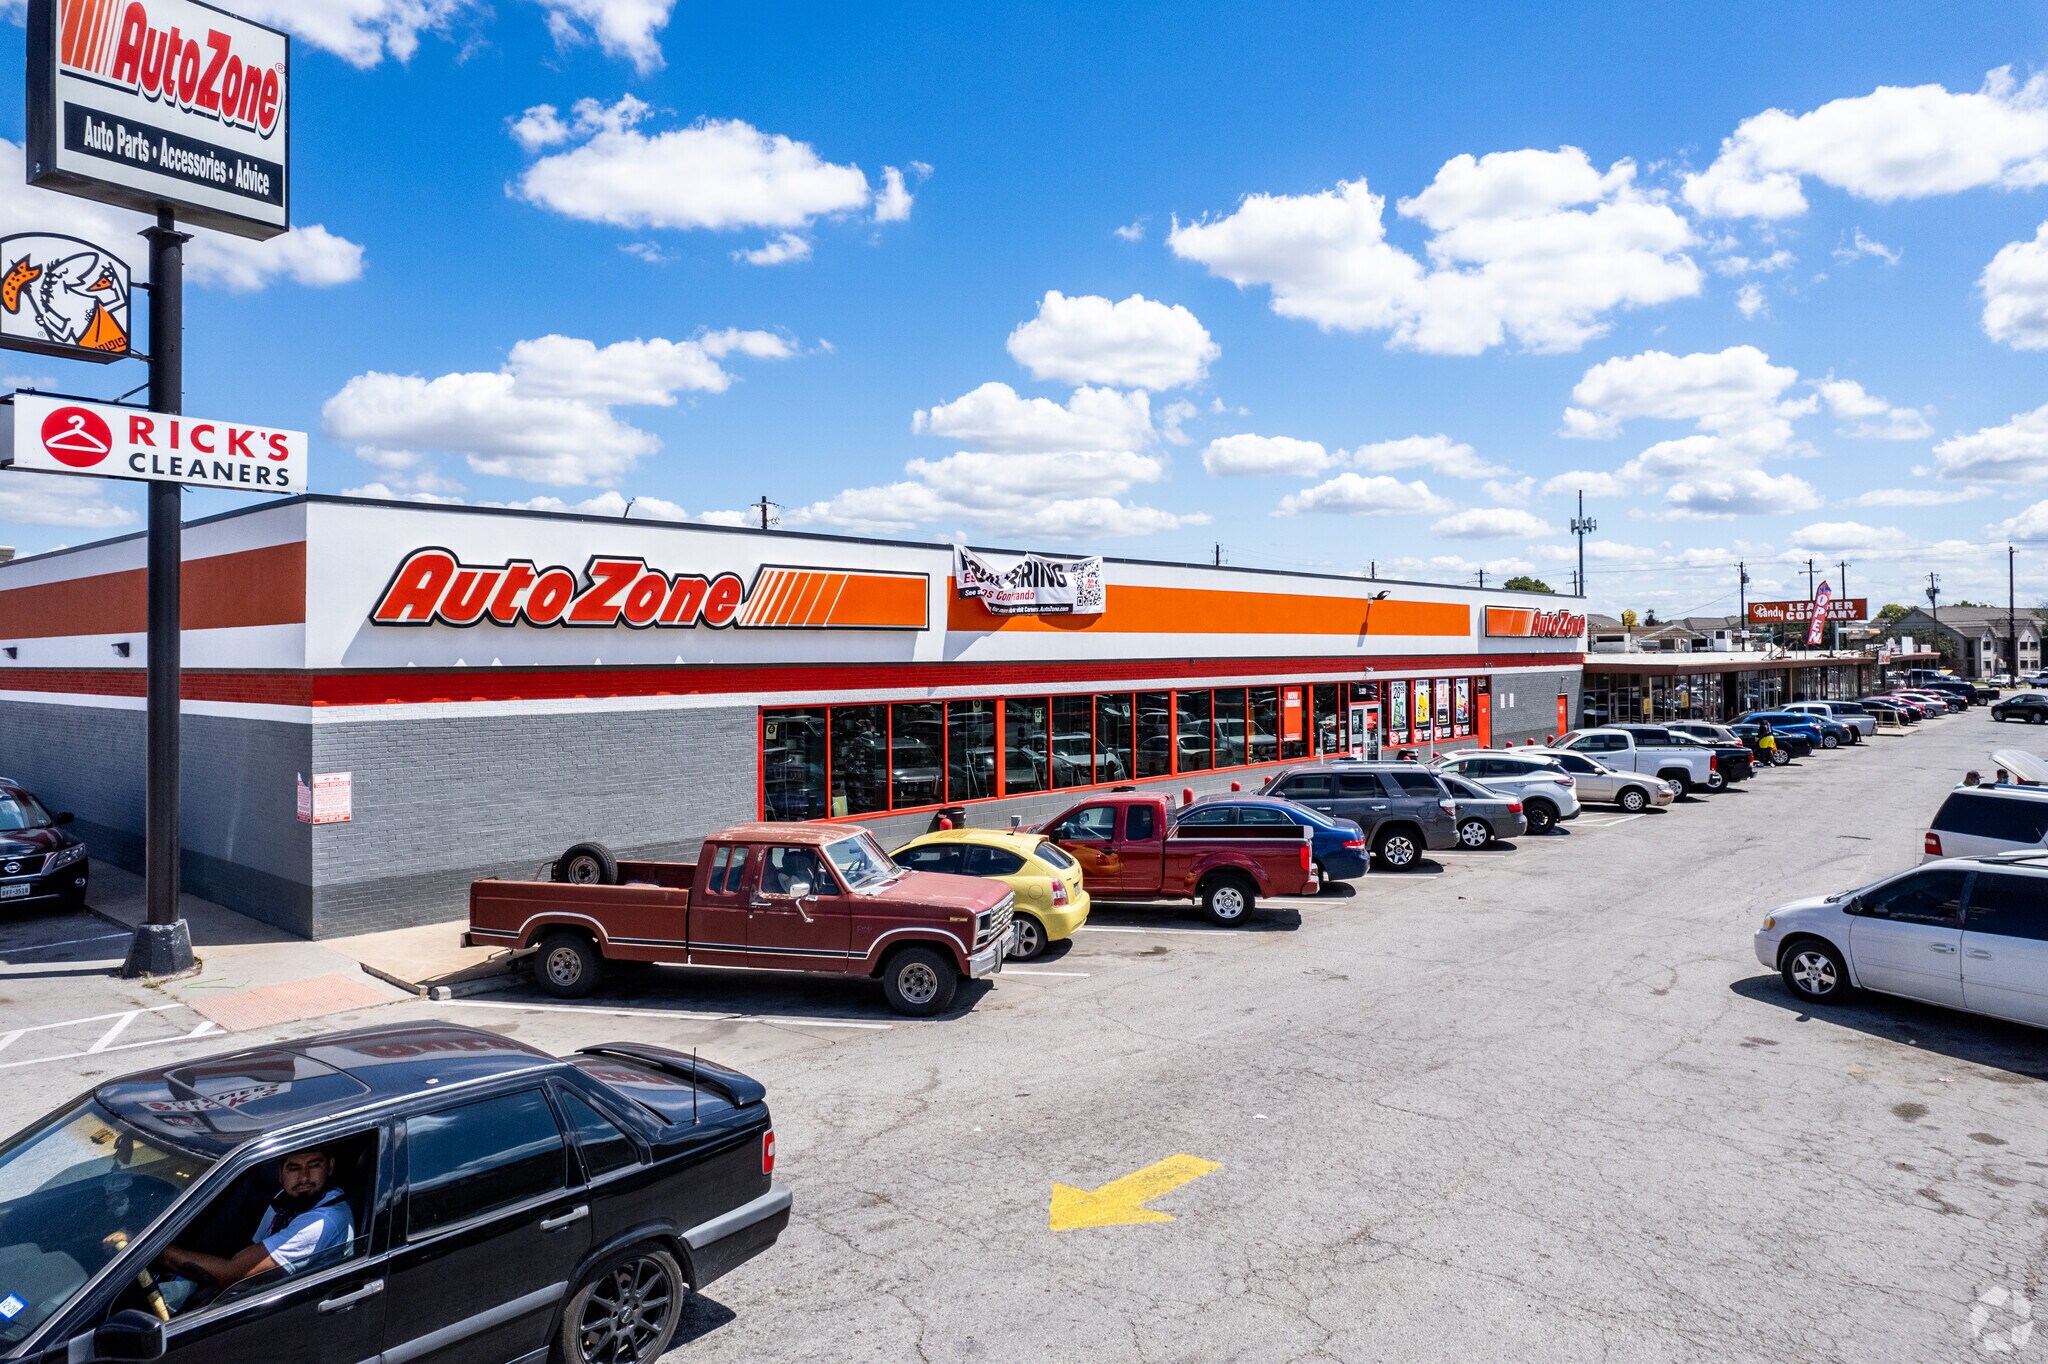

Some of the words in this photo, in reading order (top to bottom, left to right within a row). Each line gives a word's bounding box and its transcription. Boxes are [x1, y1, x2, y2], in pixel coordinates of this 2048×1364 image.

[111, 1, 280, 132] AutoZone
[83, 115, 115, 154] Auto
[116, 124, 150, 163] Parts
[159, 136, 227, 184] Accessories
[235, 159, 270, 196] Advice
[128, 414, 290, 462] RICK'S
[128, 452, 290, 487] CLEANERS
[372, 550, 743, 626] AutoZone
[1788, 601, 1854, 612] LEAHER
[1530, 609, 1586, 637] AutoZone
[1786, 609, 1857, 621] COANY
[1809, 594, 1828, 643] OPEN
